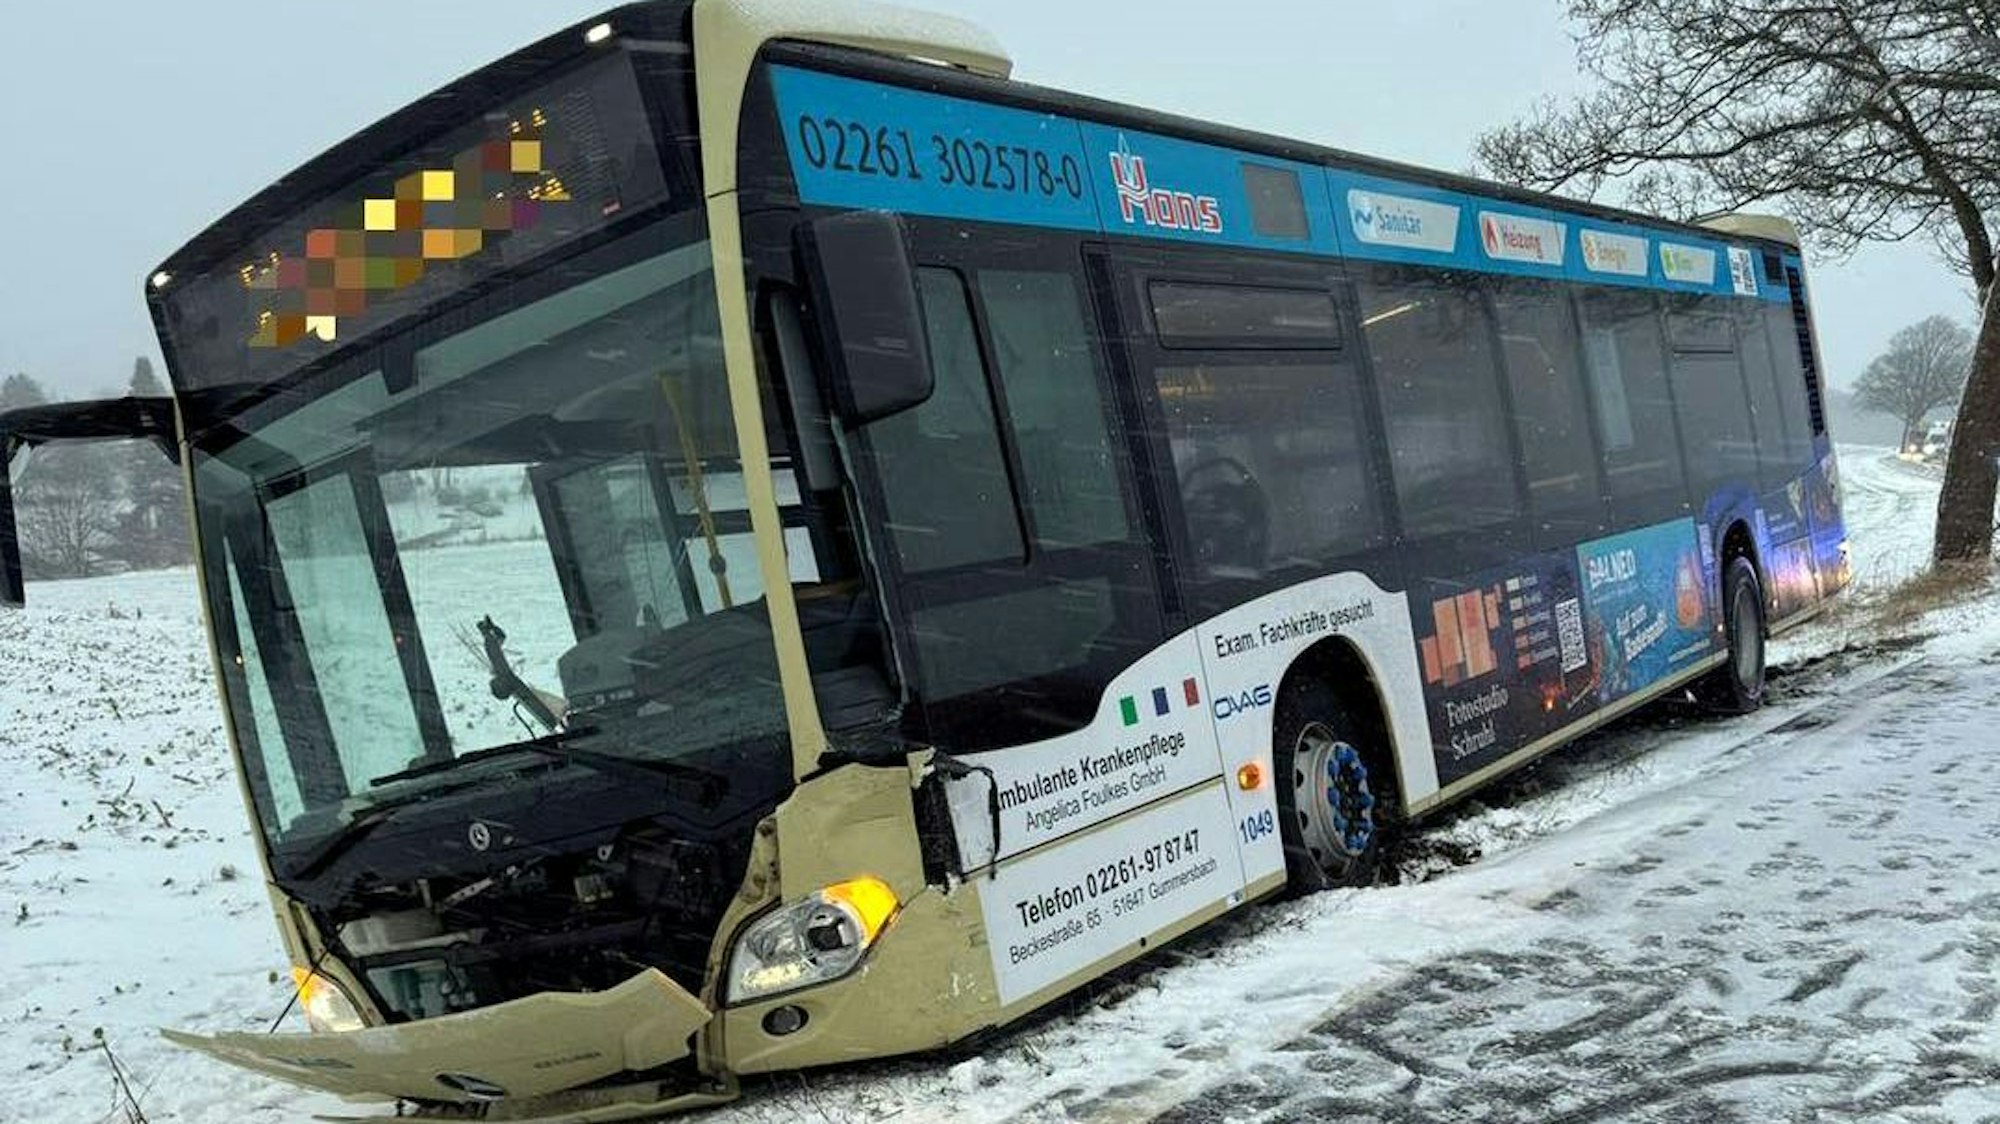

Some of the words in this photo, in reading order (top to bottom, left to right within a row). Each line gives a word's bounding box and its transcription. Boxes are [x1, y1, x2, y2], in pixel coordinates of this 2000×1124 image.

[800, 116, 921, 179] 02261
[932, 136, 1081, 199] 302578-0
[1215, 632, 1259, 658] Exam.
[1260, 611, 1328, 645] Fachkräfte
[1329, 600, 1374, 632] gesucht
[1445, 684, 1509, 728] Fotostudio
[999, 766, 1077, 811] mbulante
[1080, 732, 1186, 782] Krankenpflege
[1027, 797, 1081, 832] Angelica
[1082, 781, 1128, 811] Foulkes
[1130, 764, 1167, 792] GmbH
[1239, 809, 1274, 844] 1049
[1009, 918, 1084, 965] Beckestraße
[1087, 908, 1102, 930] 65
[1113, 888, 1145, 917] 51647
[1149, 857, 1218, 899] Gummersbach
[1016, 884, 1084, 927] Telefon
